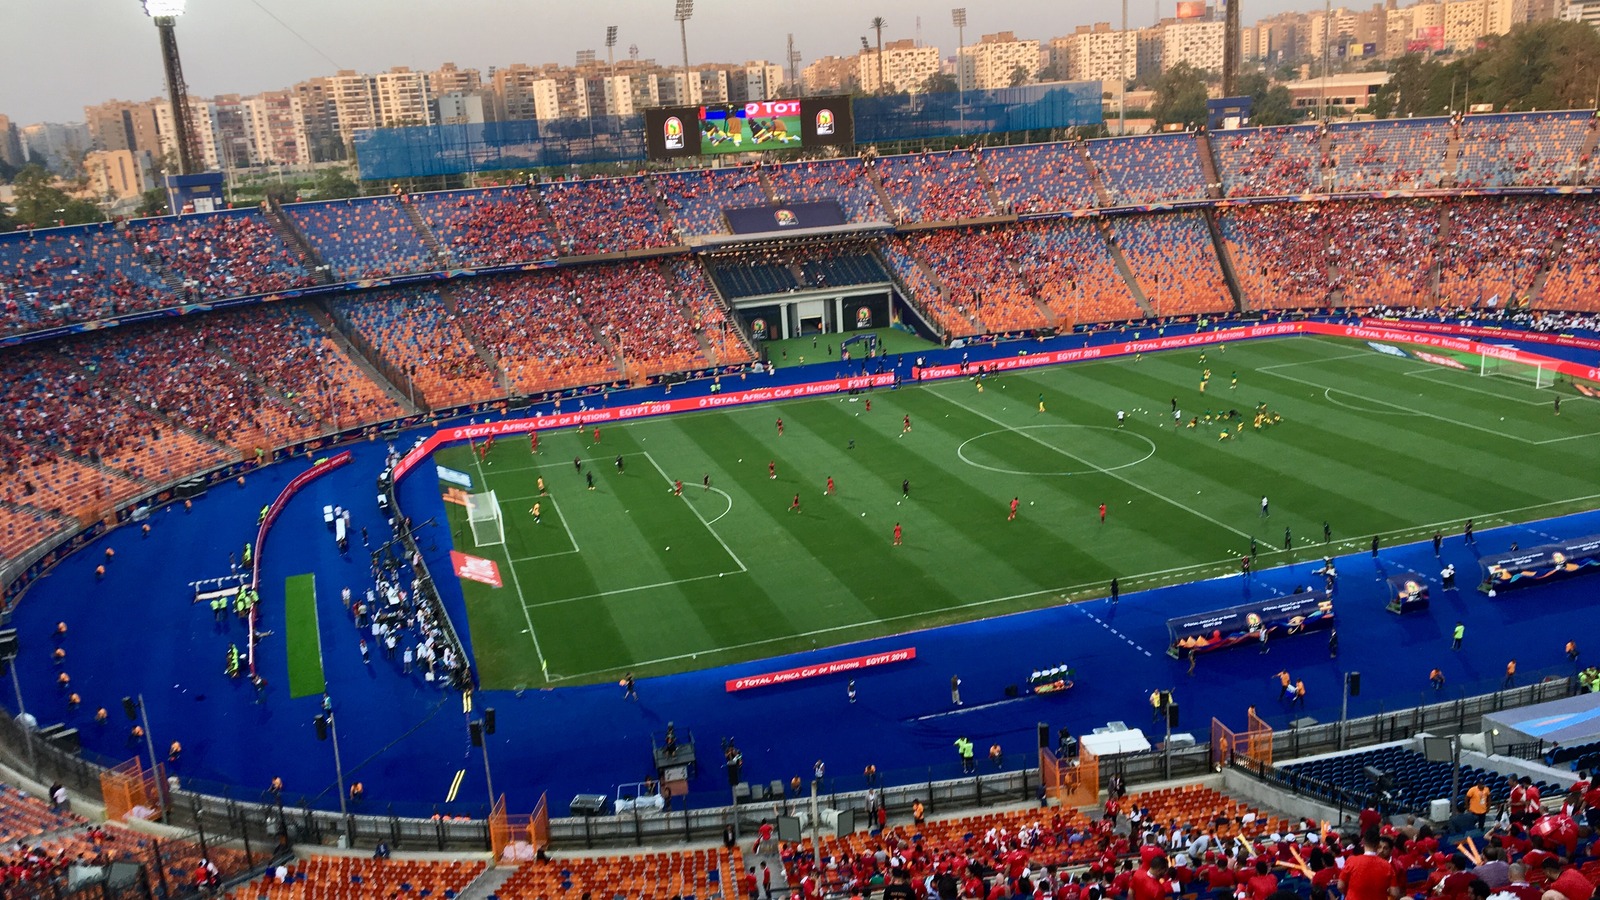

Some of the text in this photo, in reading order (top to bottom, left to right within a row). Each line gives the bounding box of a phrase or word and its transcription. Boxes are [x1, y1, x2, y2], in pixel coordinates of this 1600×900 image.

[762, 102, 800, 113] TOT
[1132, 324, 1295, 351] TOTAL AFRICA CUP OF NATIONS EGYPT 2019
[1353, 328, 1381, 339] TOTAL
[1384, 331, 1412, 342] AFRICA
[1414, 334, 1429, 344] CUP
[1431, 337, 1440, 345] OF
[1441, 338, 1470, 349] NATIONS
[929, 368, 957, 377] TOTAL
[1019, 355, 1050, 366] NATIONS
[1057, 350, 1082, 361] EGYPT
[1084, 348, 1100, 358] 2019
[708, 395, 739, 406] TOTAL
[742, 391, 773, 402] AFRICA
[774, 387, 792, 398] CUP
[794, 386, 805, 396] OF
[806, 382, 840, 395] NATIONS
[876, 374, 895, 385] 2019
[500, 420, 535, 432] AFRICA
[538, 415, 556, 428] CUP
[559, 414, 571, 425] OF
[619, 405, 649, 417] EGYPT
[651, 403, 671, 414] 2019
[744, 651, 908, 687] TOTAL AFRICA CUP OF NATIONS EGYPT 2019
